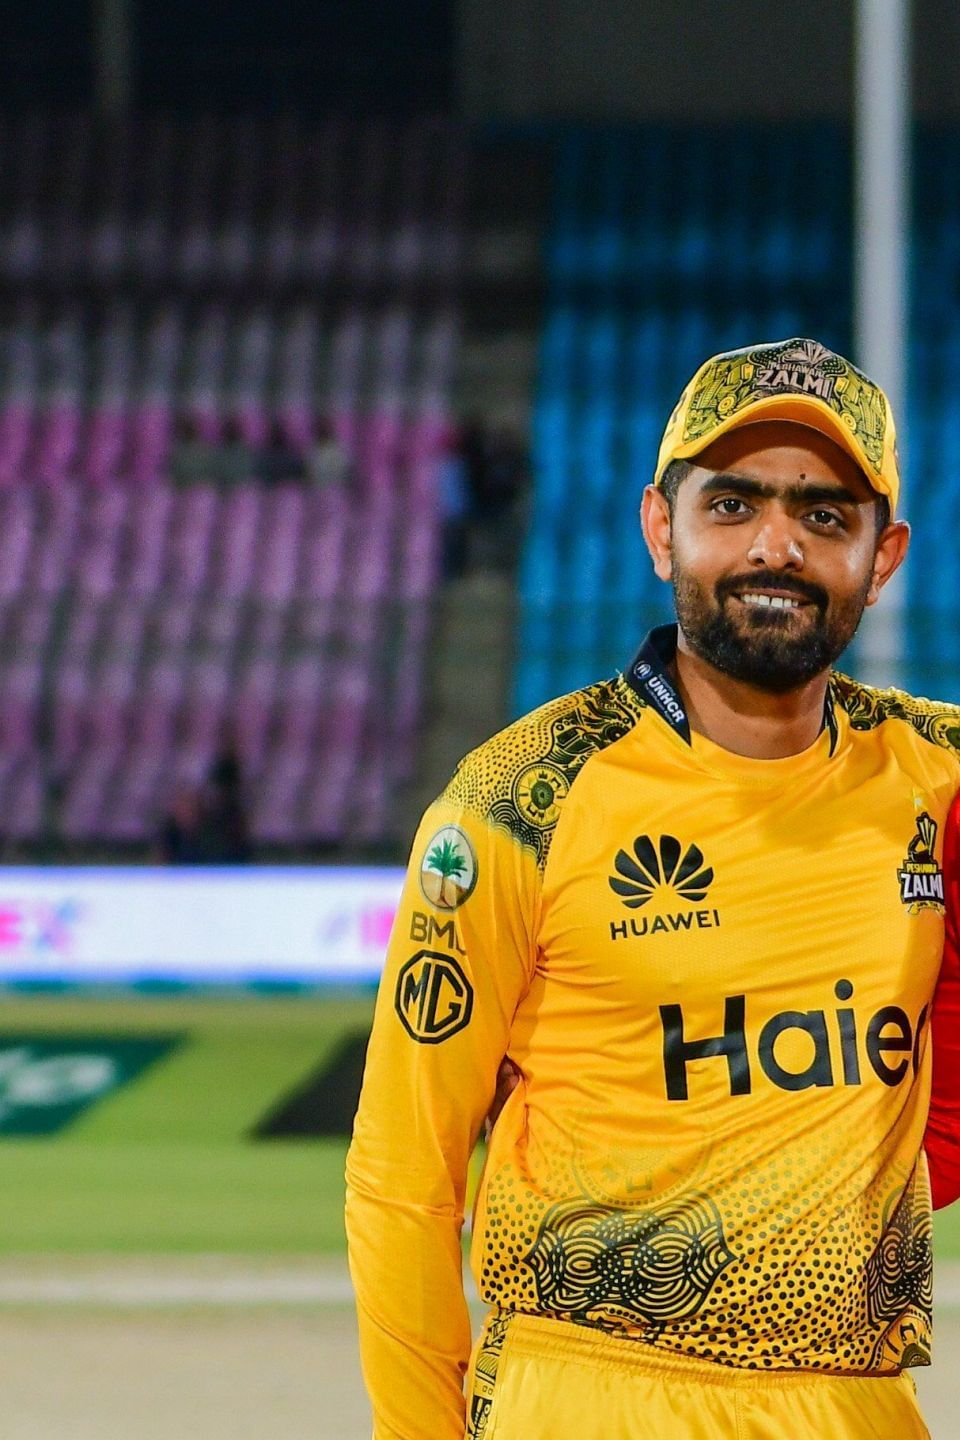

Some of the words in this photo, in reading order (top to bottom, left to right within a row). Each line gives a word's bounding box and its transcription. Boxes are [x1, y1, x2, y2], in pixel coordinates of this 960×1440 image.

[757, 370, 833, 399] ZALMI
[648, 676, 685, 723] UNHCR
[901, 872, 944, 900] ZALMI
[610, 909, 721, 940] HUAWEI
[403, 962, 464, 1033] MG
